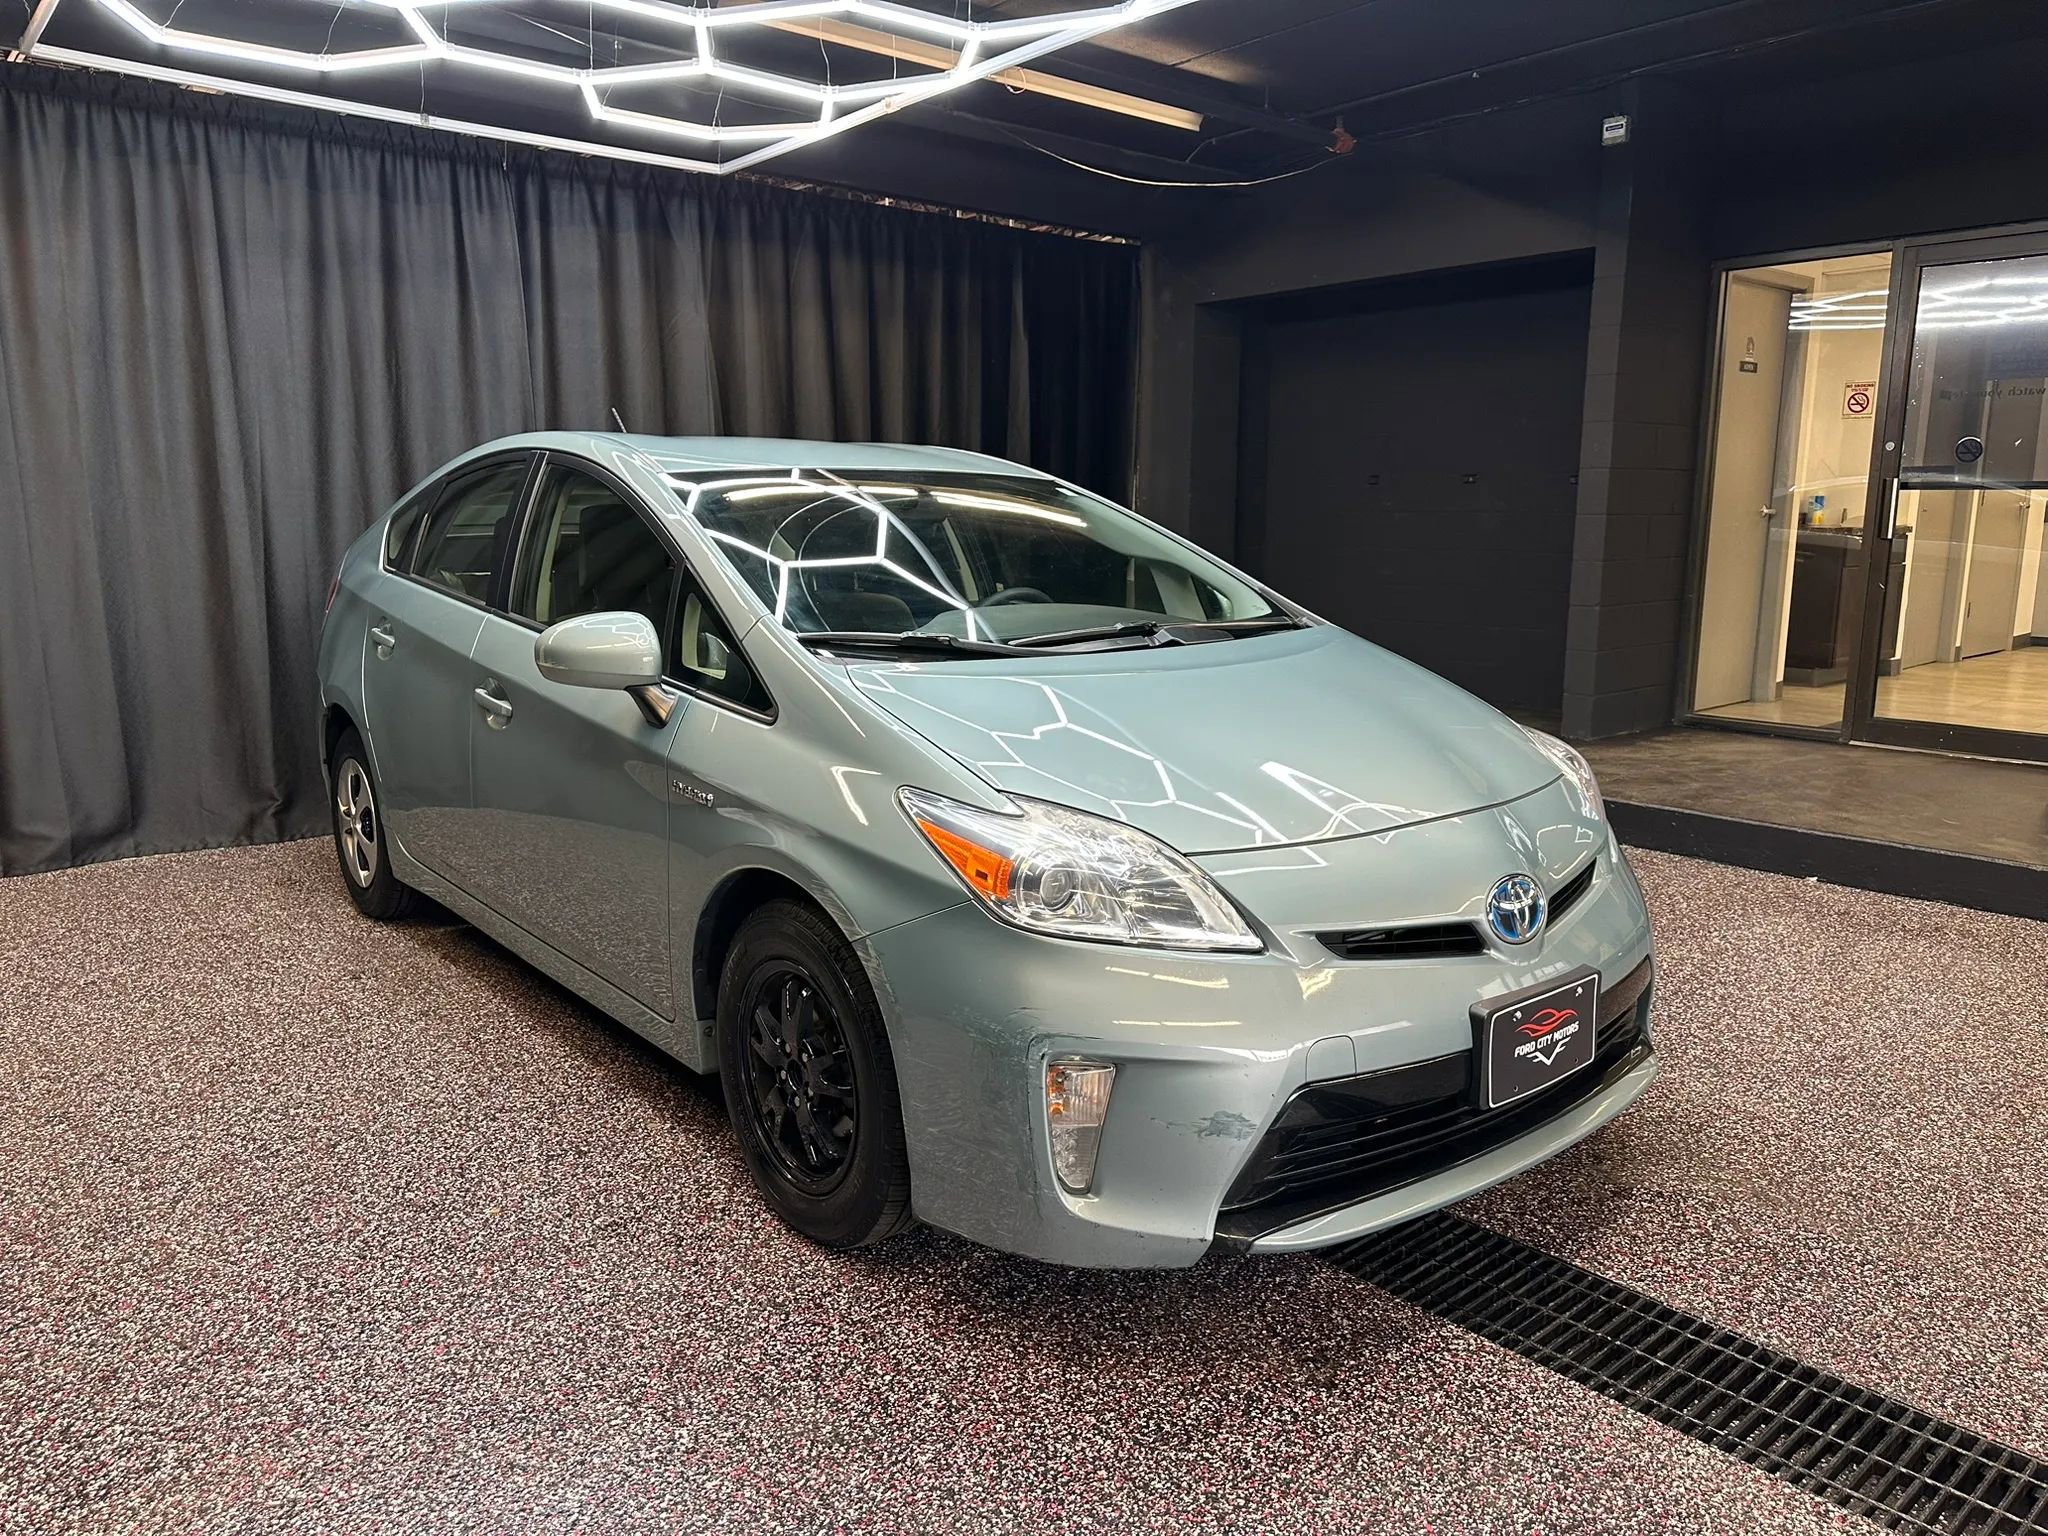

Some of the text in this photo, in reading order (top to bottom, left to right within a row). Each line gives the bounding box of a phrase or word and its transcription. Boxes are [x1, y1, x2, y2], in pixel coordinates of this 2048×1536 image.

[1514, 1020, 1580, 1058] FORD CITY MOTORS
